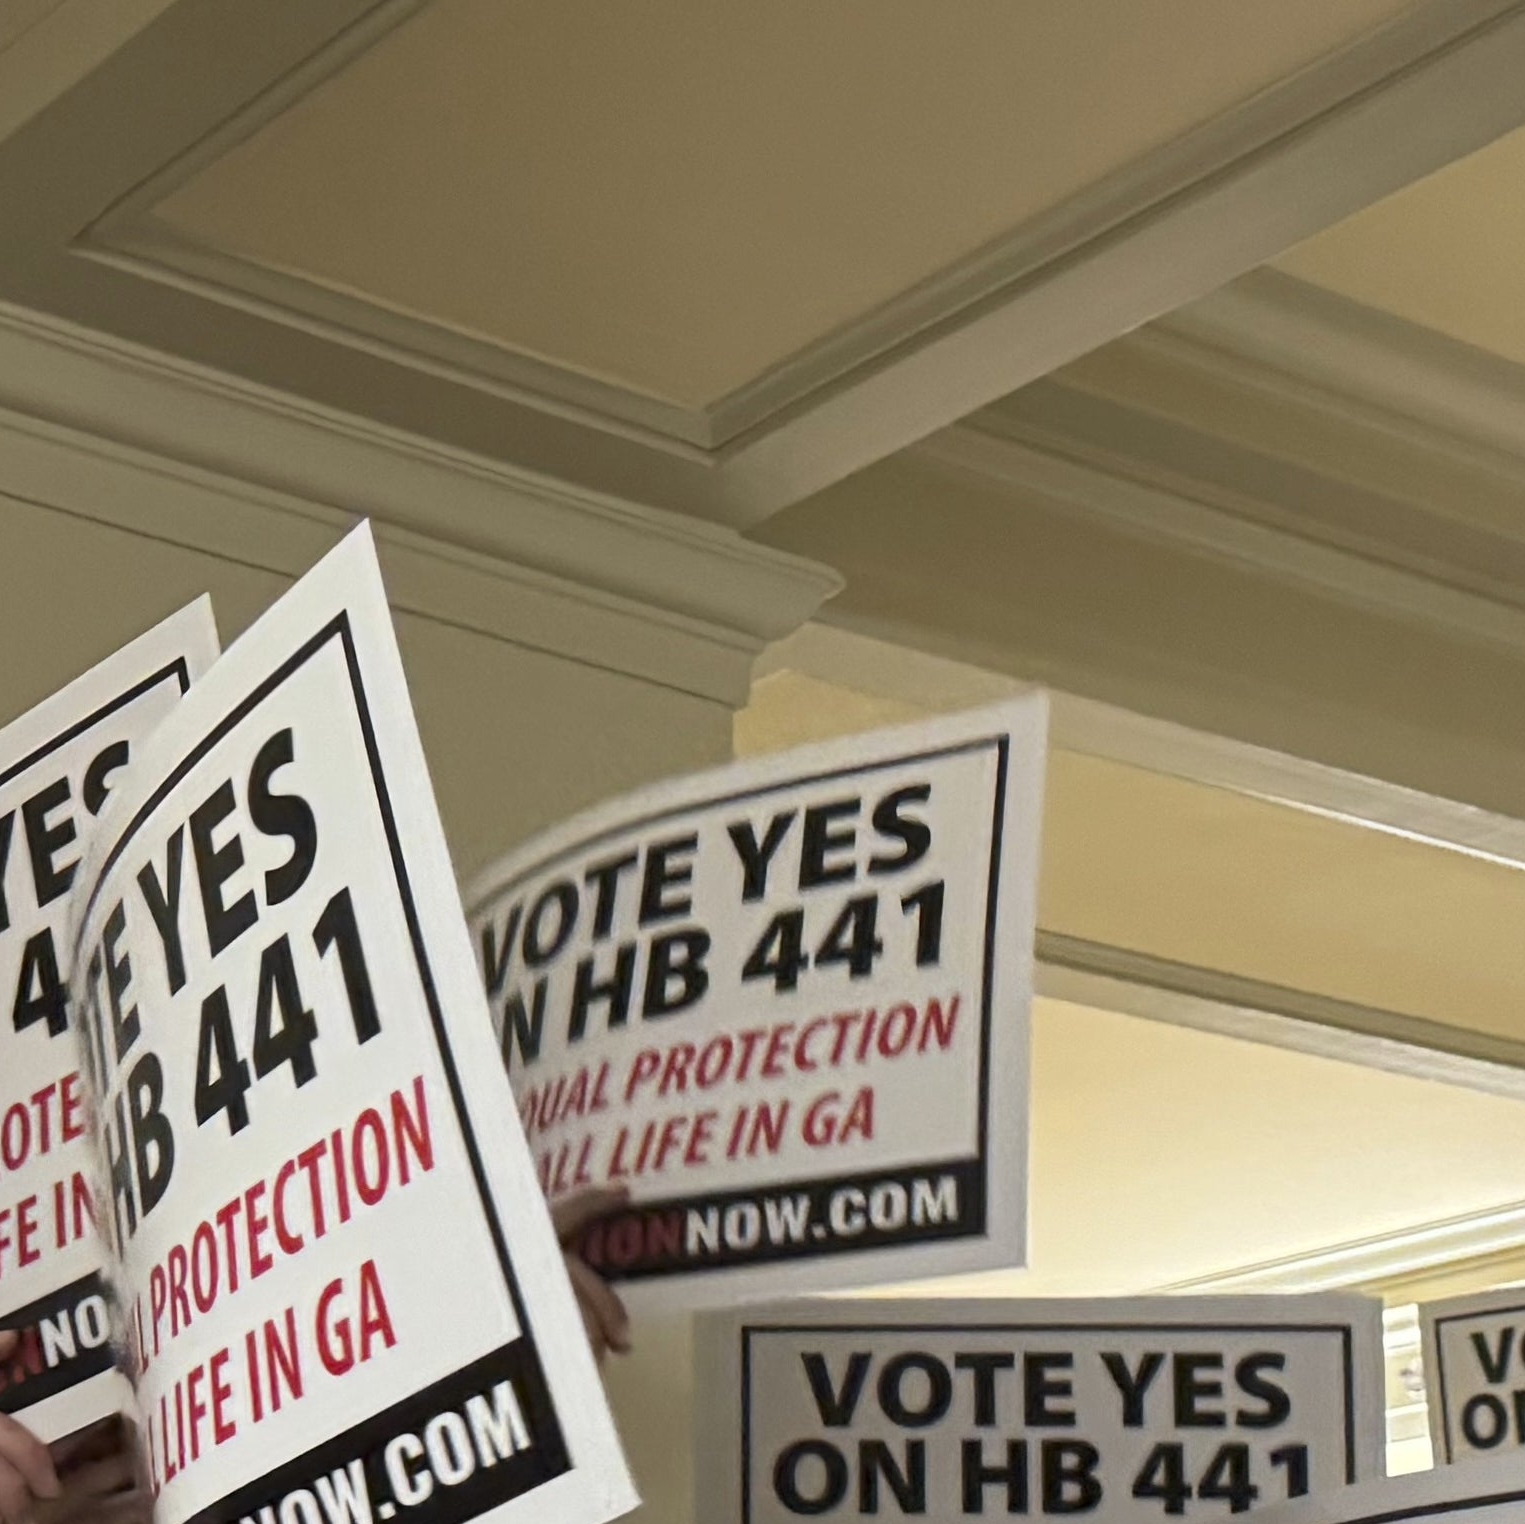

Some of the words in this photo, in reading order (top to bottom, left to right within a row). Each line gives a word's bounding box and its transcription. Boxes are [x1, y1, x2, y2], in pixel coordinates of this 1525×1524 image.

[135, 727, 318, 998] YES
[480, 832, 699, 995] VOTE
[726, 783, 933, 904] YES
[193, 885, 385, 1138] 441
[568, 928, 712, 1044] HB
[741, 879, 945, 995] 441
[625, 994, 962, 1103] PROTECTION
[148, 1073, 436, 1358] PROTECTION
[607, 1110, 719, 1181] LIFE
[726, 1100, 789, 1161] IN
[800, 1086, 875, 1148] GA
[158, 1347, 237, 1495] LIFE
[245, 1307, 306, 1423] IN
[315, 1258, 398, 1377] GA
[799, 1351, 1077, 1428] VOTE
[1100, 1351, 1293, 1429] YES
[772, 1437, 927, 1516] ON
[960, 1439, 1104, 1516] HB
[1131, 1441, 1311, 1516] 441
